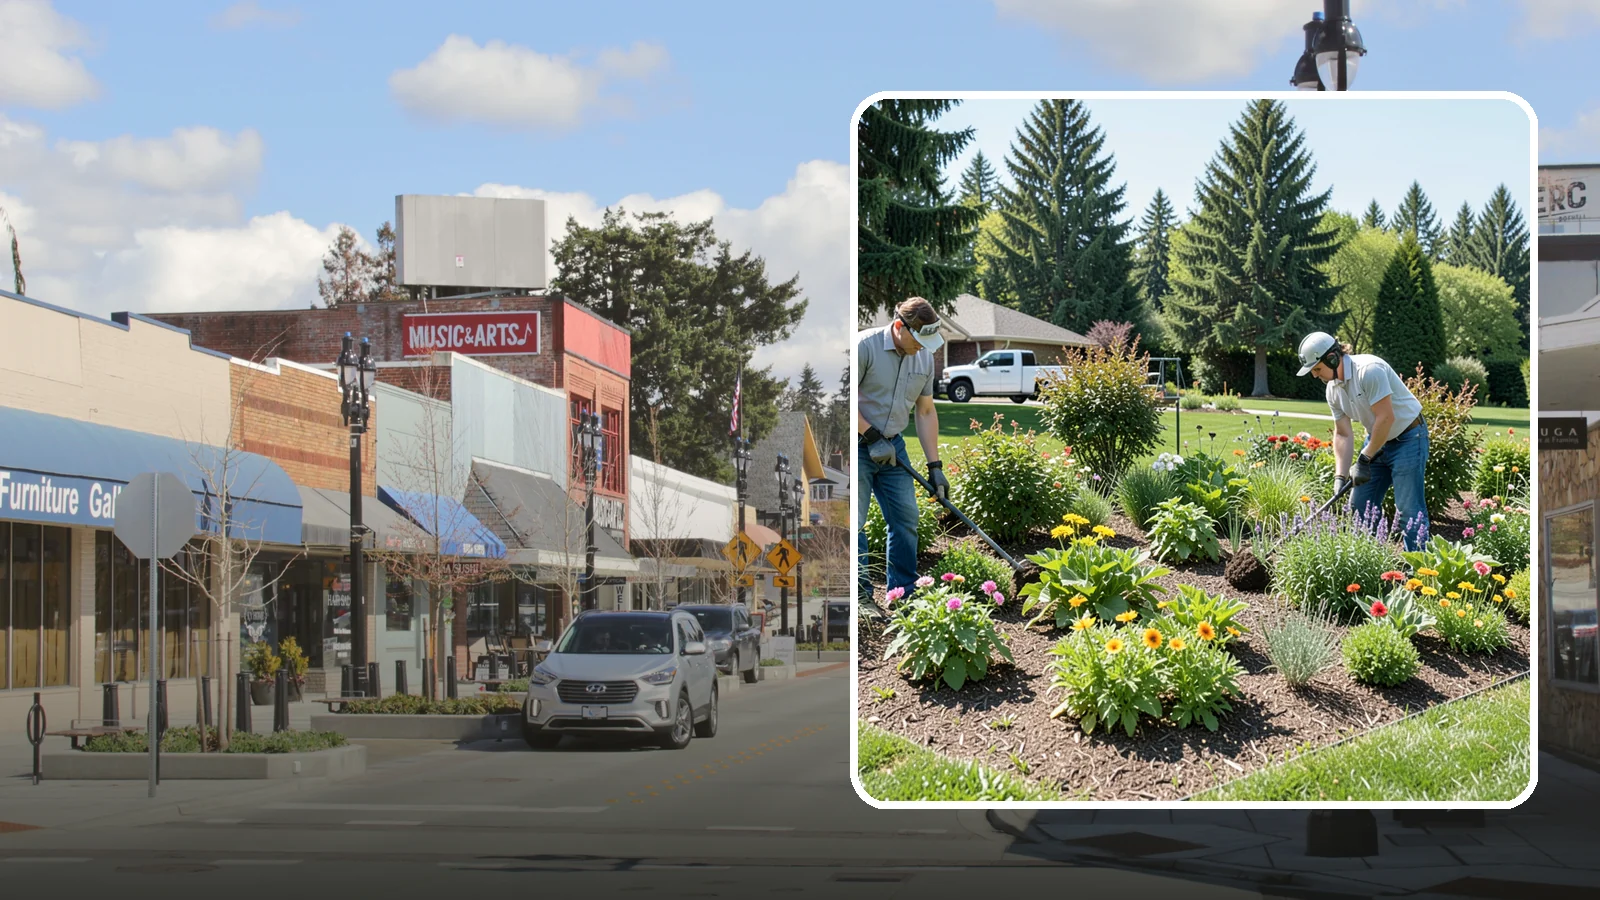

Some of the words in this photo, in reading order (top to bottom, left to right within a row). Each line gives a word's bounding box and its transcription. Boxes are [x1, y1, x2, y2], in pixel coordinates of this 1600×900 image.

[409, 323, 519, 348] MUSIC&ARTS
[1540, 428, 1577, 436] UGA
[0, 471, 79, 515] Furniture
[89, 482, 121, 518] Gal
